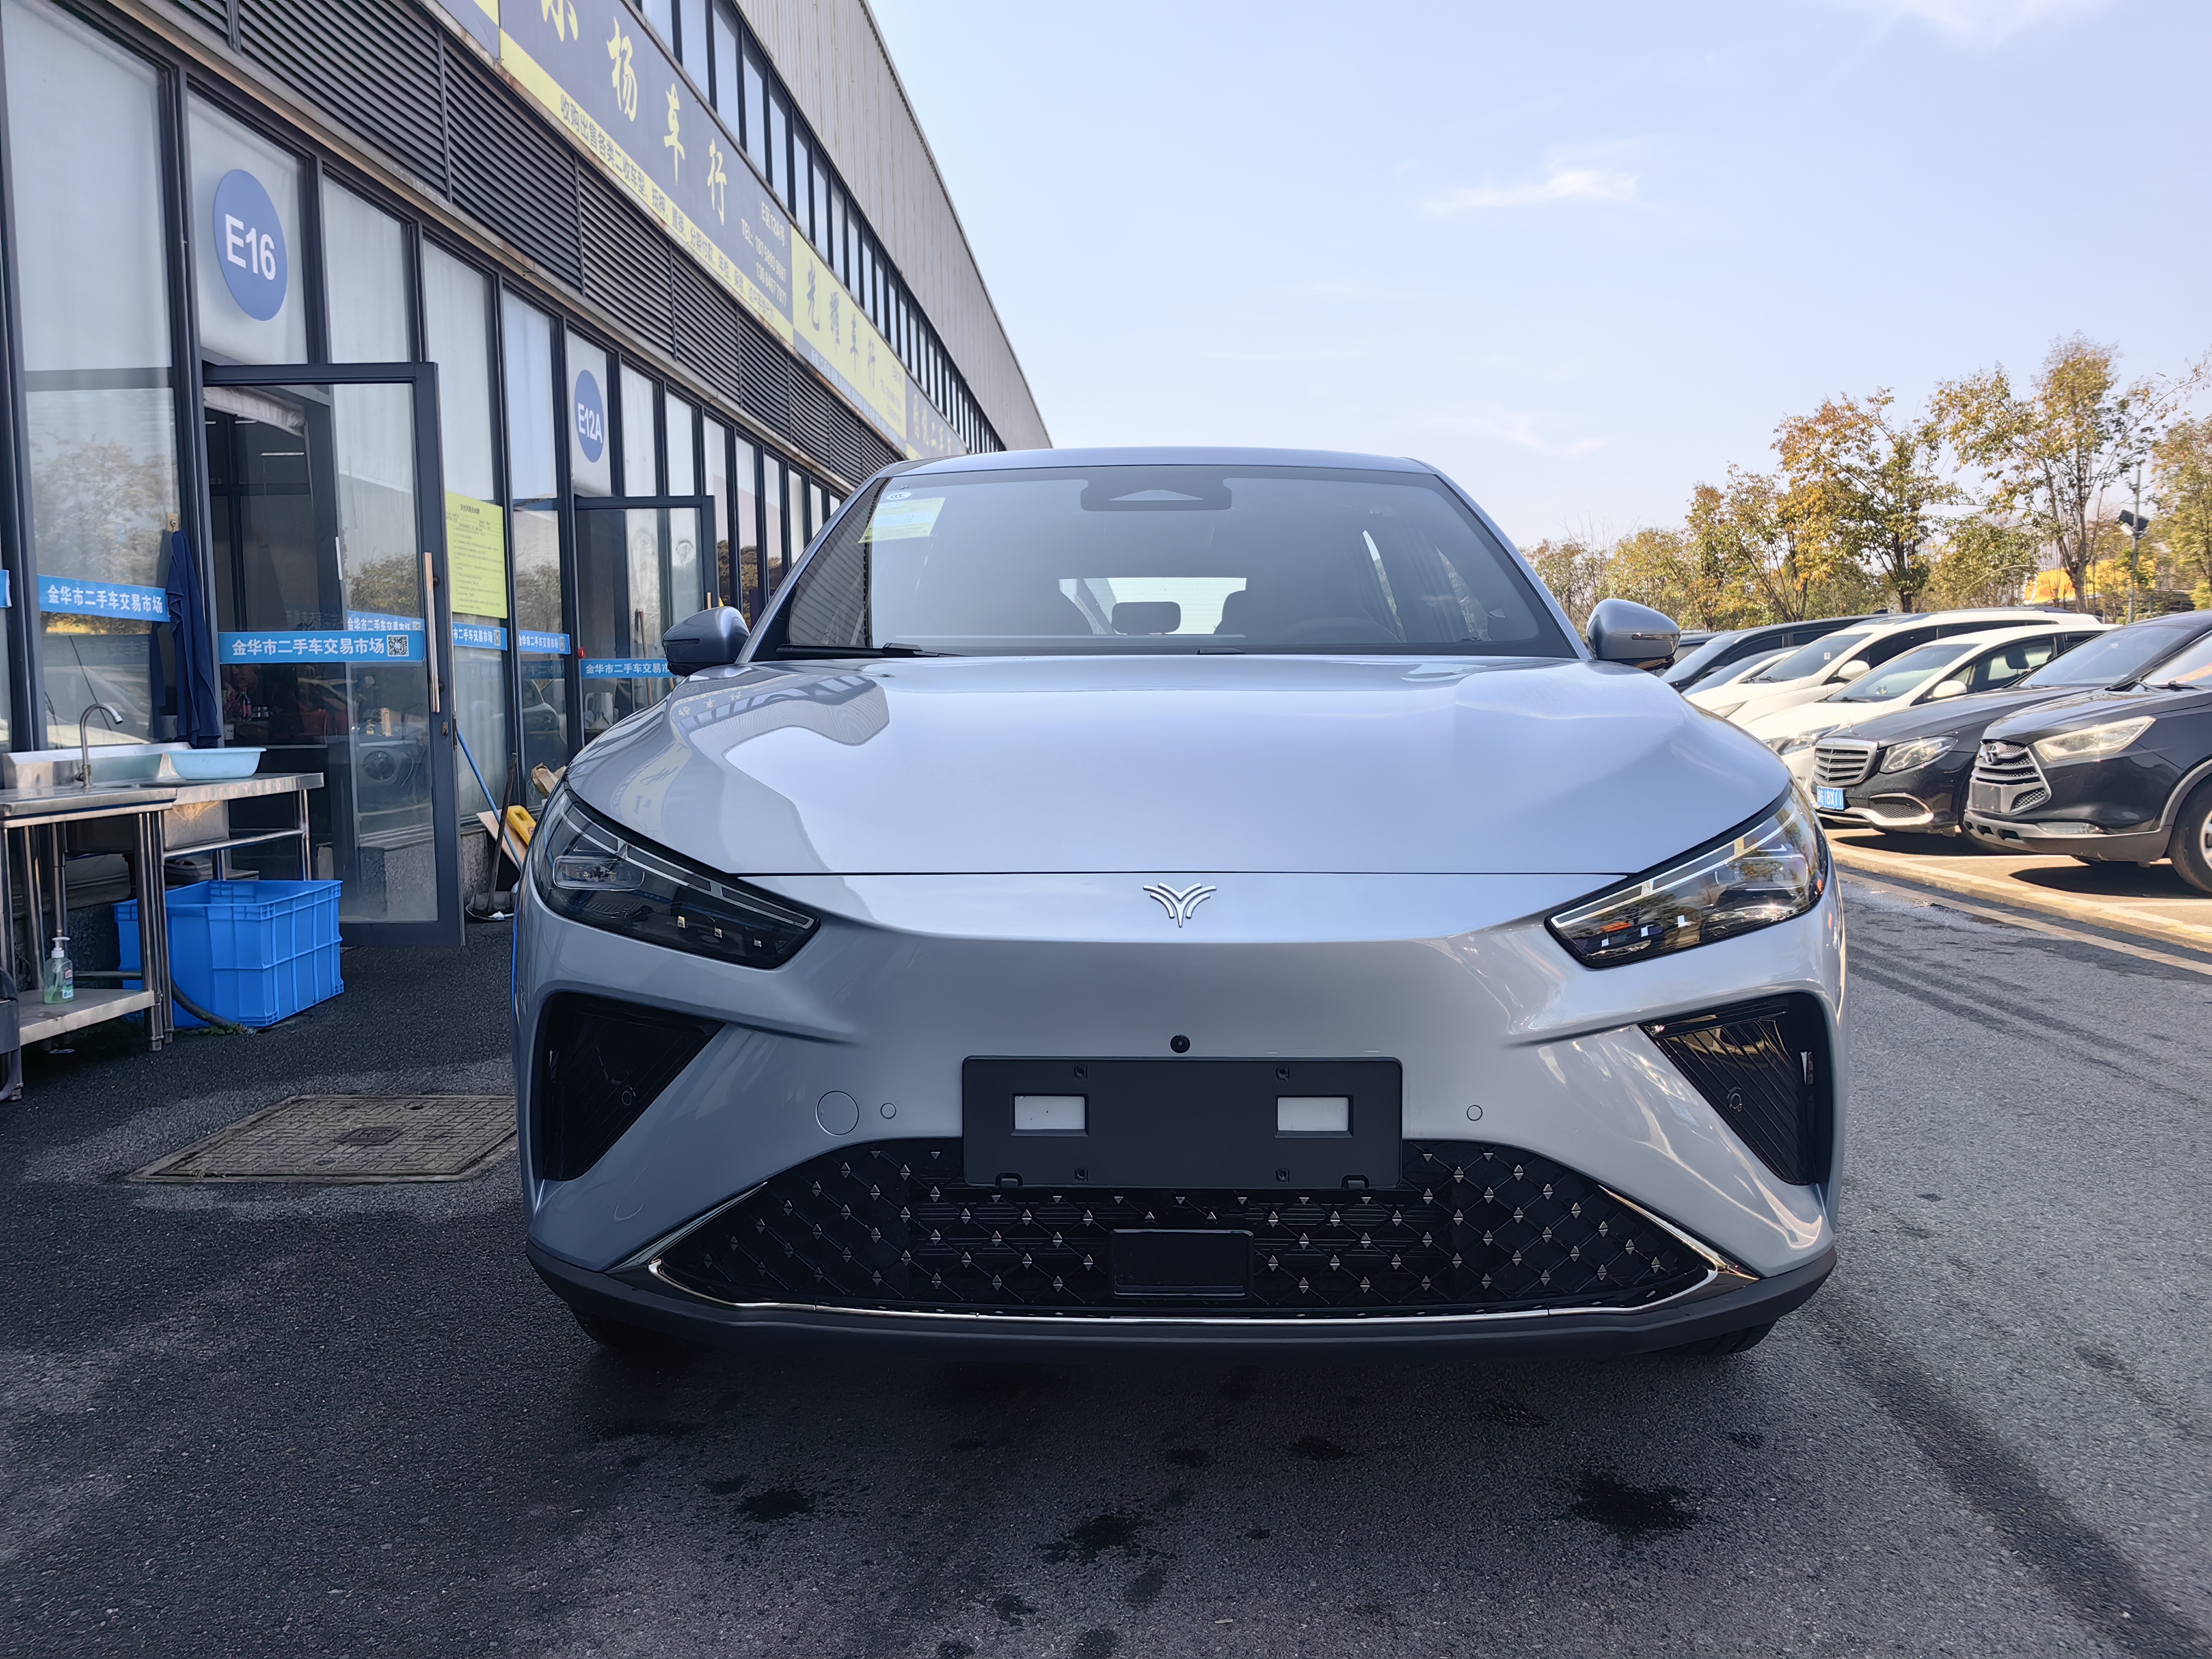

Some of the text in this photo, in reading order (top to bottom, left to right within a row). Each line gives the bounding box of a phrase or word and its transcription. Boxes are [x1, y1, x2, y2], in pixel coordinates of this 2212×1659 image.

[225, 213, 276, 280] E16
[578, 402, 603, 443] E12A
[48, 584, 163, 613] 金华市二手车交易市场
[232, 638, 385, 656] 金华市二手车交易市场
